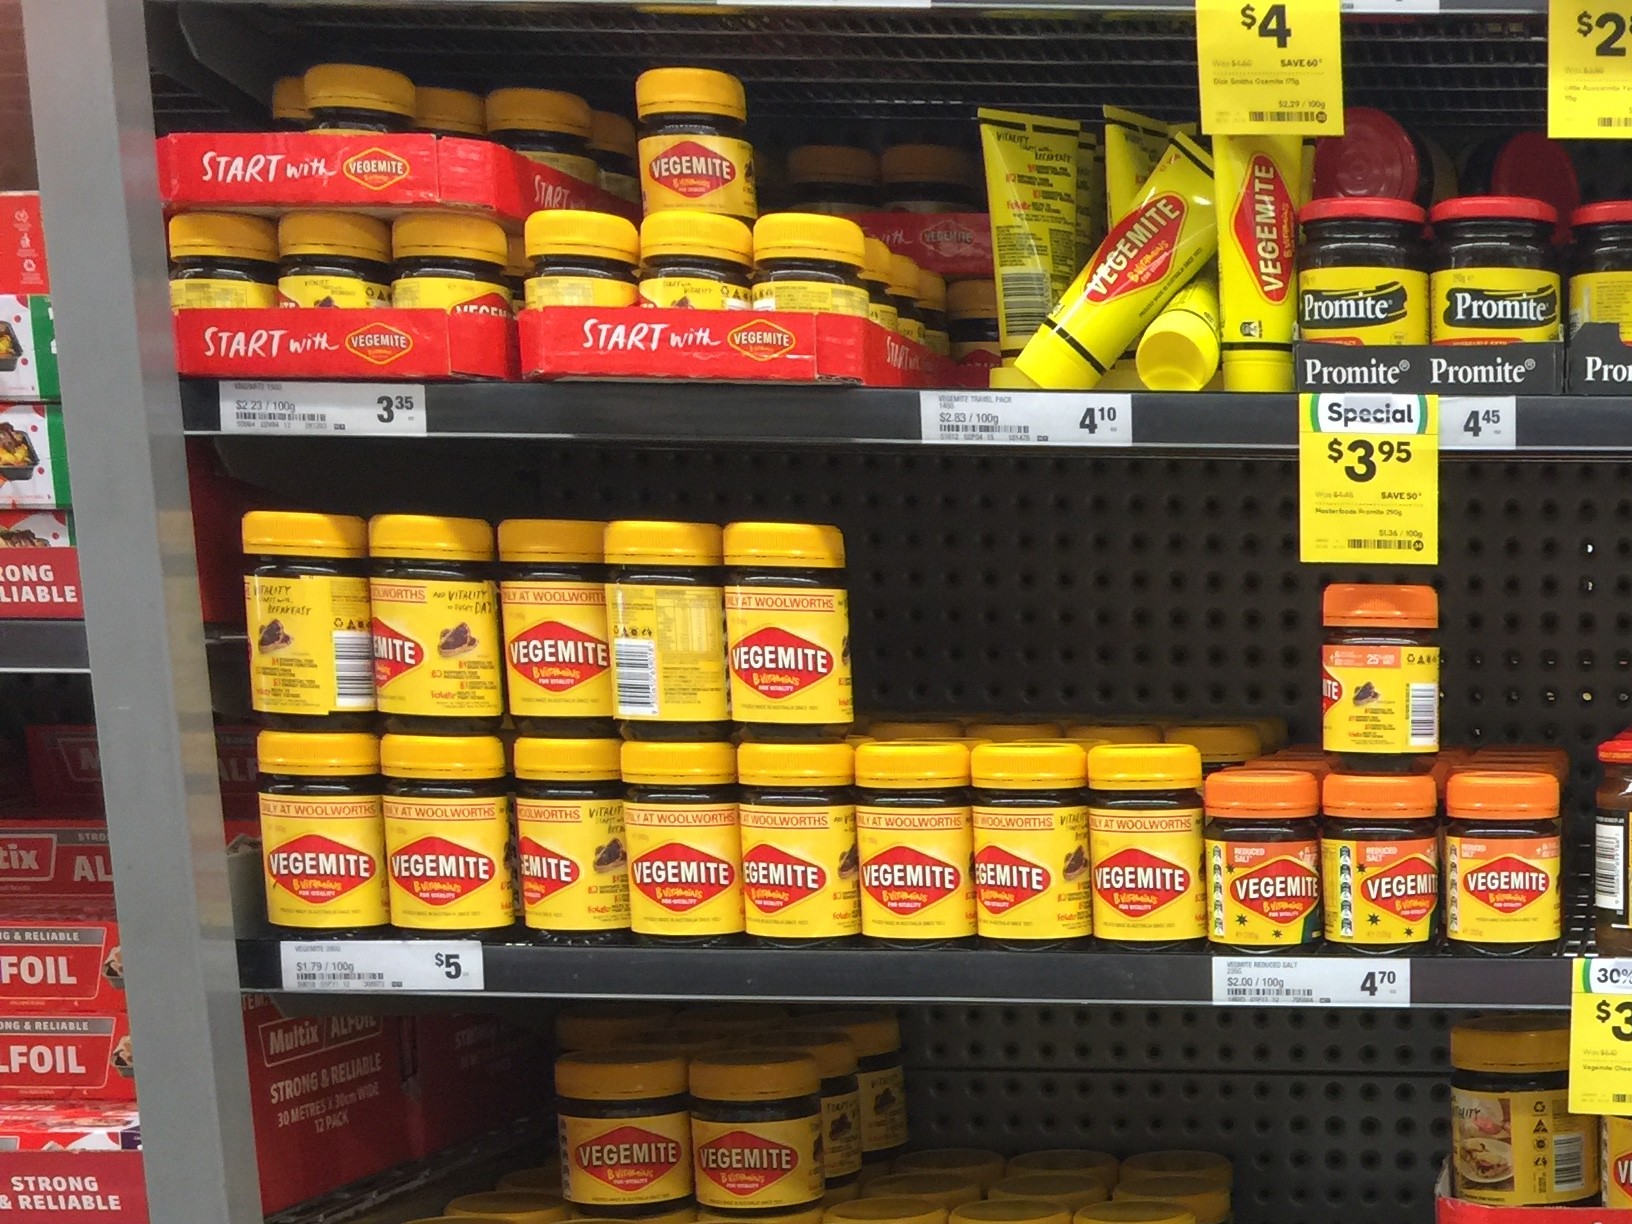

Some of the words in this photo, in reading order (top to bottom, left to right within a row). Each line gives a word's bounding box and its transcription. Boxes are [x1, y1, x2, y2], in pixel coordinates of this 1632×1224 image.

[1240, 3, 1292, 48] $4
[651, 155, 732, 182] VEGEMITE
[1253, 162, 1278, 293] VEGEMITE
[1086, 198, 1181, 298] VEGEMITE
[1455, 293, 1550, 321] Promite
[204, 328, 281, 358] START
[288, 330, 340, 353] with
[350, 334, 407, 350] VEGEMITE
[582, 318, 670, 352] START
[670, 326, 721, 348] with
[734, 332, 790, 346] VEGEMITE
[1305, 360, 1400, 386] Promite
[1430, 359, 1526, 384] Promite
[1328, 402, 1414, 426] Special
[732, 642, 828, 673] VEGEMITE
[885, 817, 962, 830] WOOLWORTHS
[1234, 847, 1266, 855] REDUCED
[269, 852, 372, 879] VEGEMITE
[862, 866, 955, 889] VEGEMITE
[1095, 867, 1185, 891] VEGEMITE
[1467, 871, 1546, 892] VEGEMITE
[1228, 978, 1253, 986] $2.00
[1262, 978, 1284, 988] 100g
[11, 1176, 98, 1192] STRONG
[19, 1194, 122, 1210] RELIABLE
